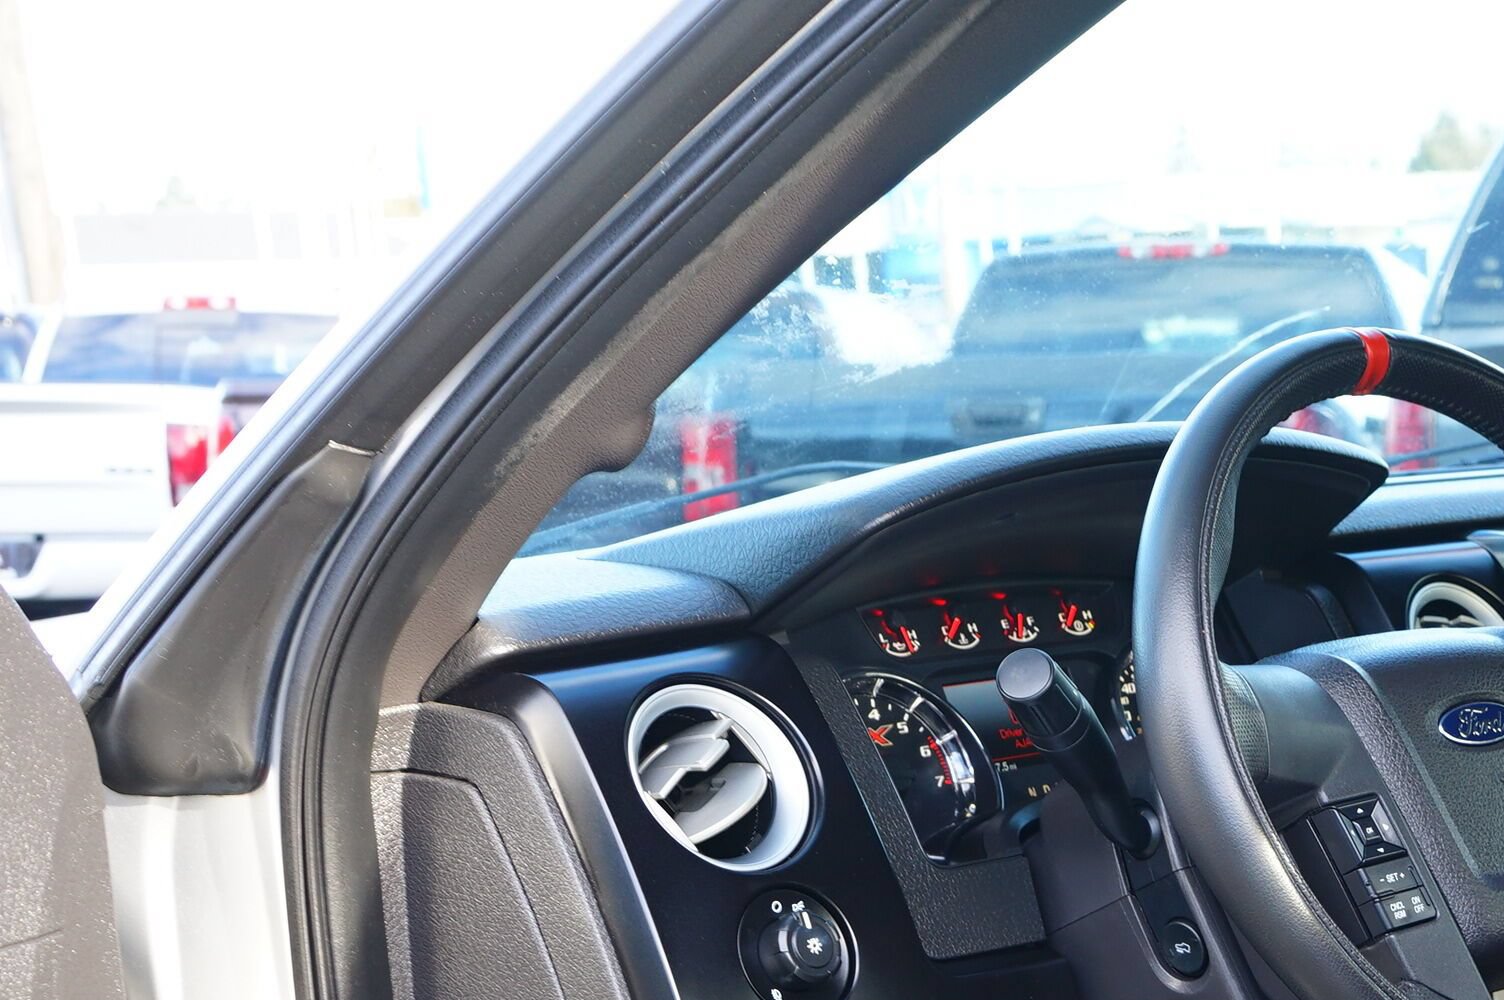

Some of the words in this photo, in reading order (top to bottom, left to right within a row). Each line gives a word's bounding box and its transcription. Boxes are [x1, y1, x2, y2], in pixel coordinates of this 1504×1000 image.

[1001, 618, 1010, 629] E
[879, 633, 888, 643] L
[868, 708, 881, 720] 4
[897, 721, 909, 734] 5
[919, 745, 932, 758] 6
[934, 775, 945, 788] 7
[1386, 872, 1399, 883] SET
[1411, 896, 1421, 905] ON
[1390, 901, 1405, 912] CNCL
[1414, 904, 1425, 914] OFF
